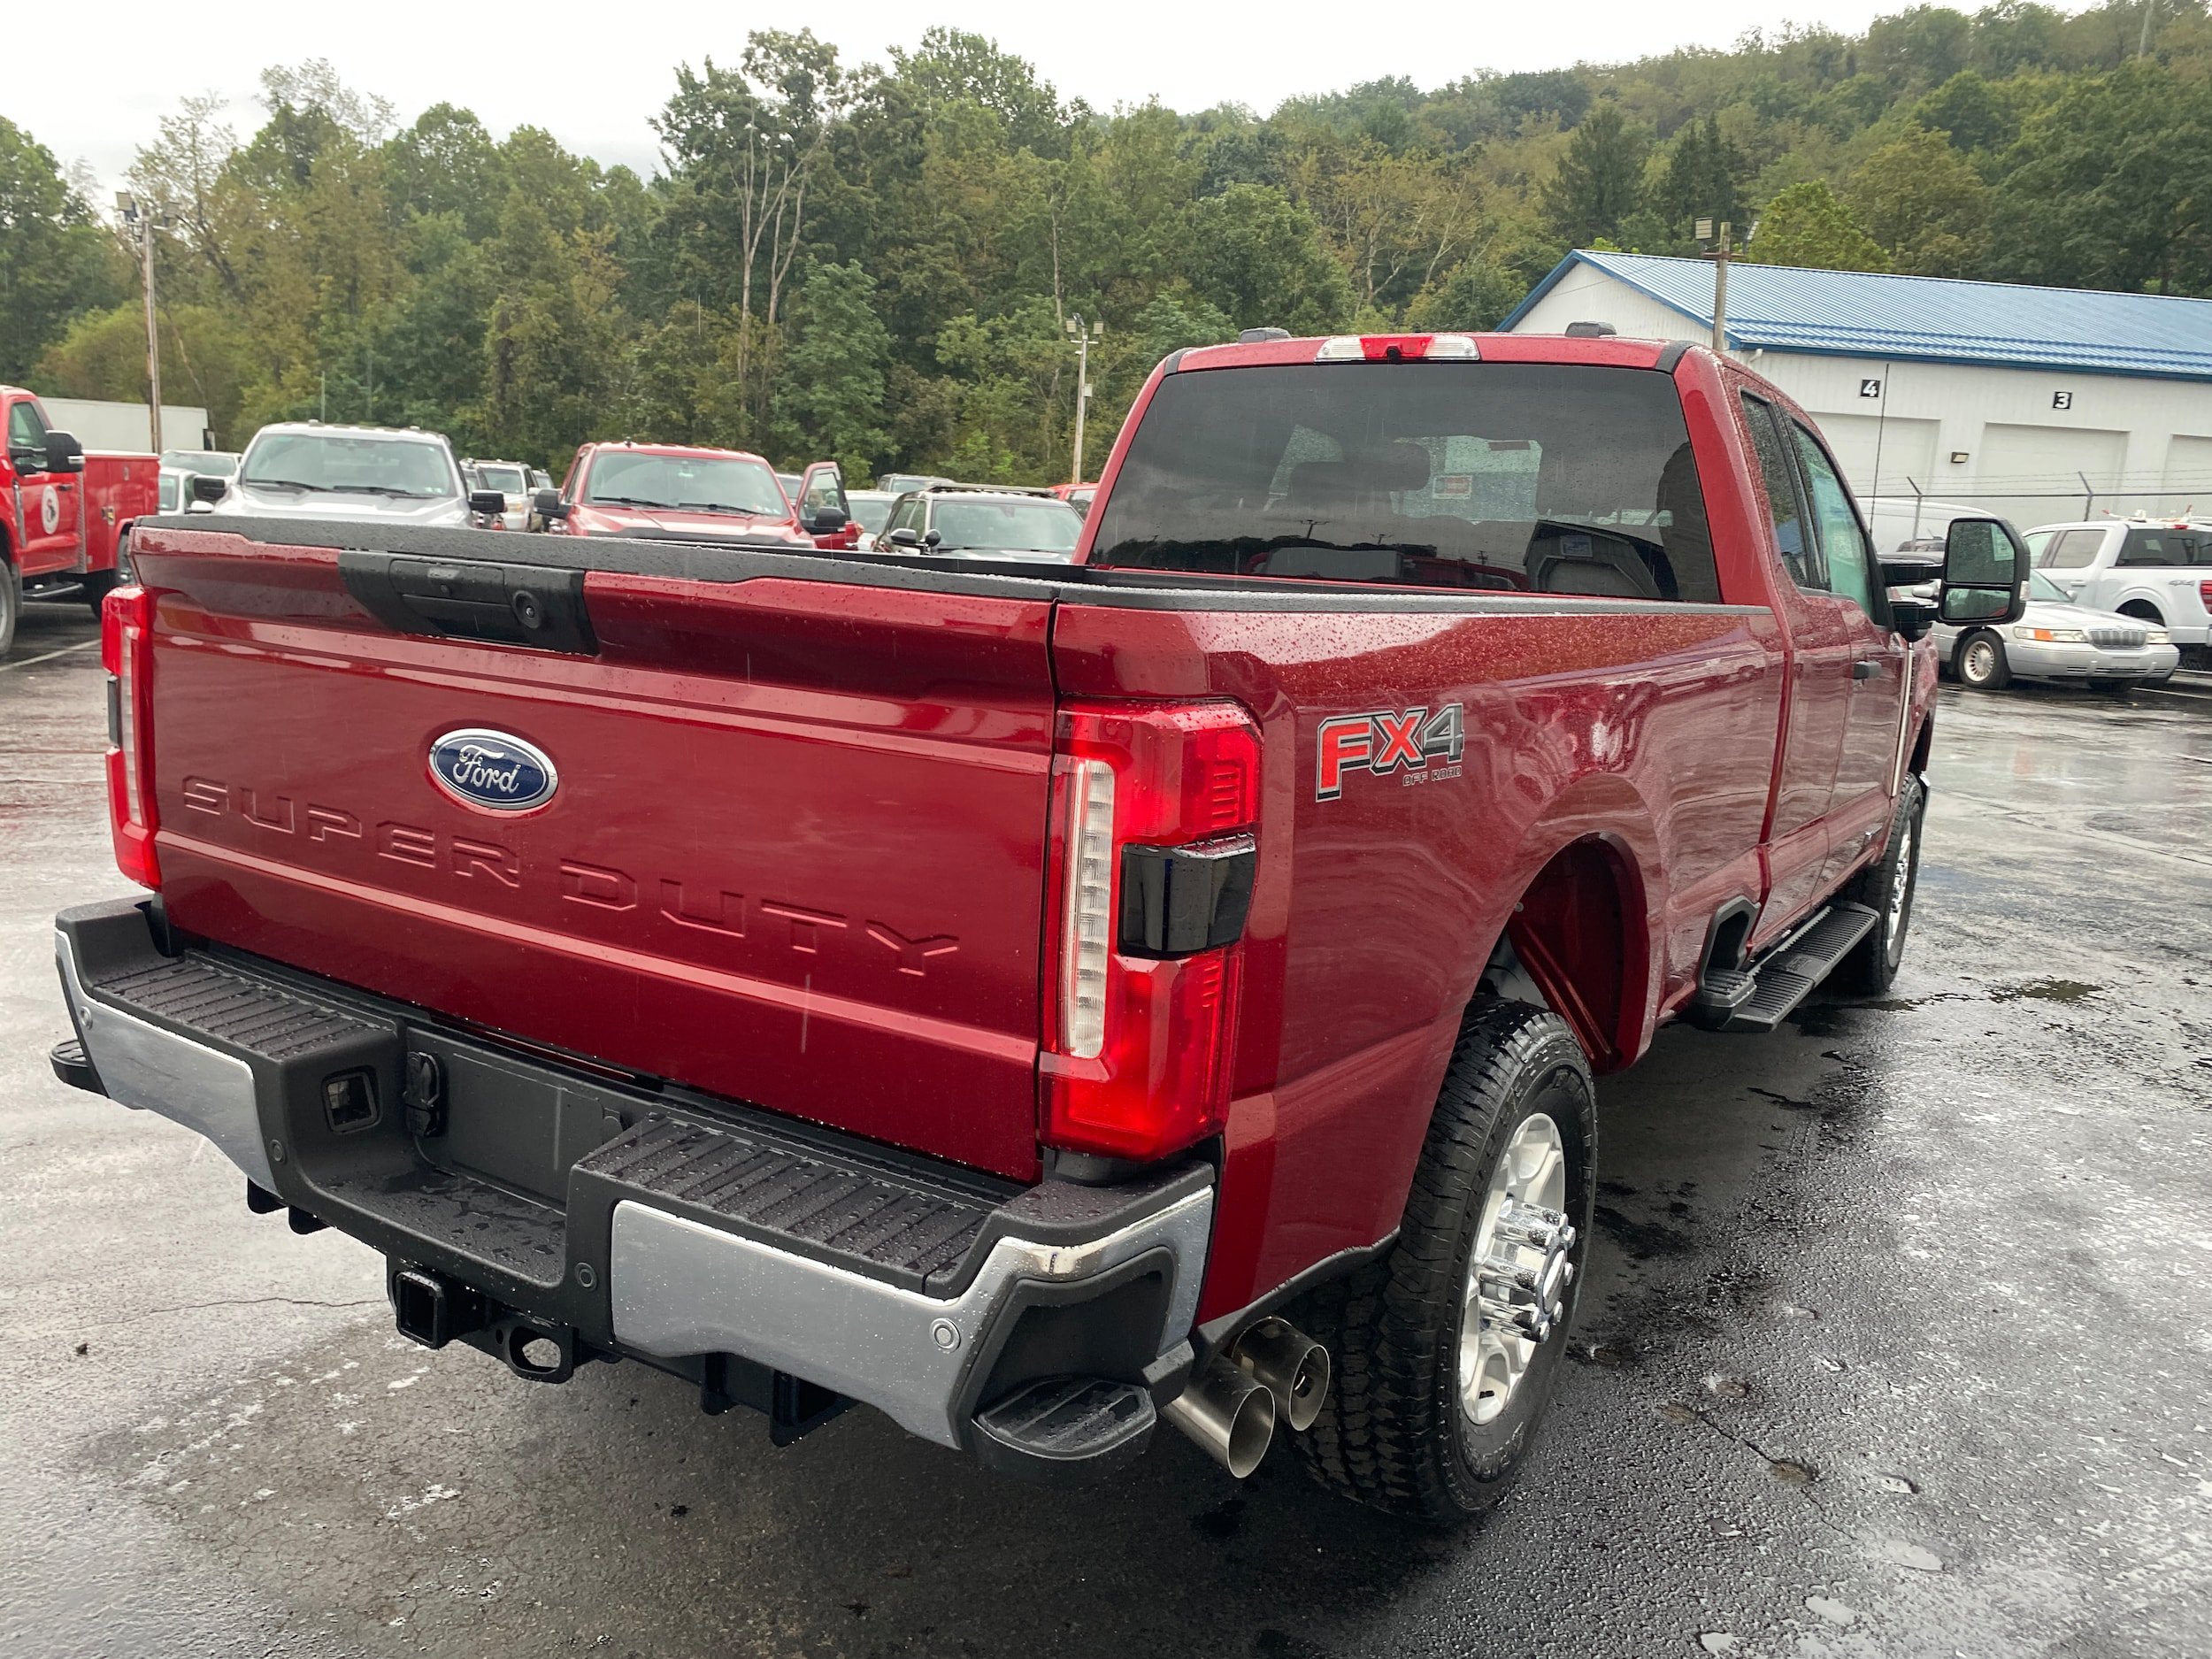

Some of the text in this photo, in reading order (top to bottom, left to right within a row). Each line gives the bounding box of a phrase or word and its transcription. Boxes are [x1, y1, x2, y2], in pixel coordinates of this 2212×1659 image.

[1863, 380, 1878, 398] 4
[2054, 392, 2070, 409] 3
[452, 744, 520, 794] Ford
[1316, 703, 1464, 803] FX4
[1402, 764, 1463, 787] OFF ROAD
[182, 775, 960, 978] SUPER DUTY
